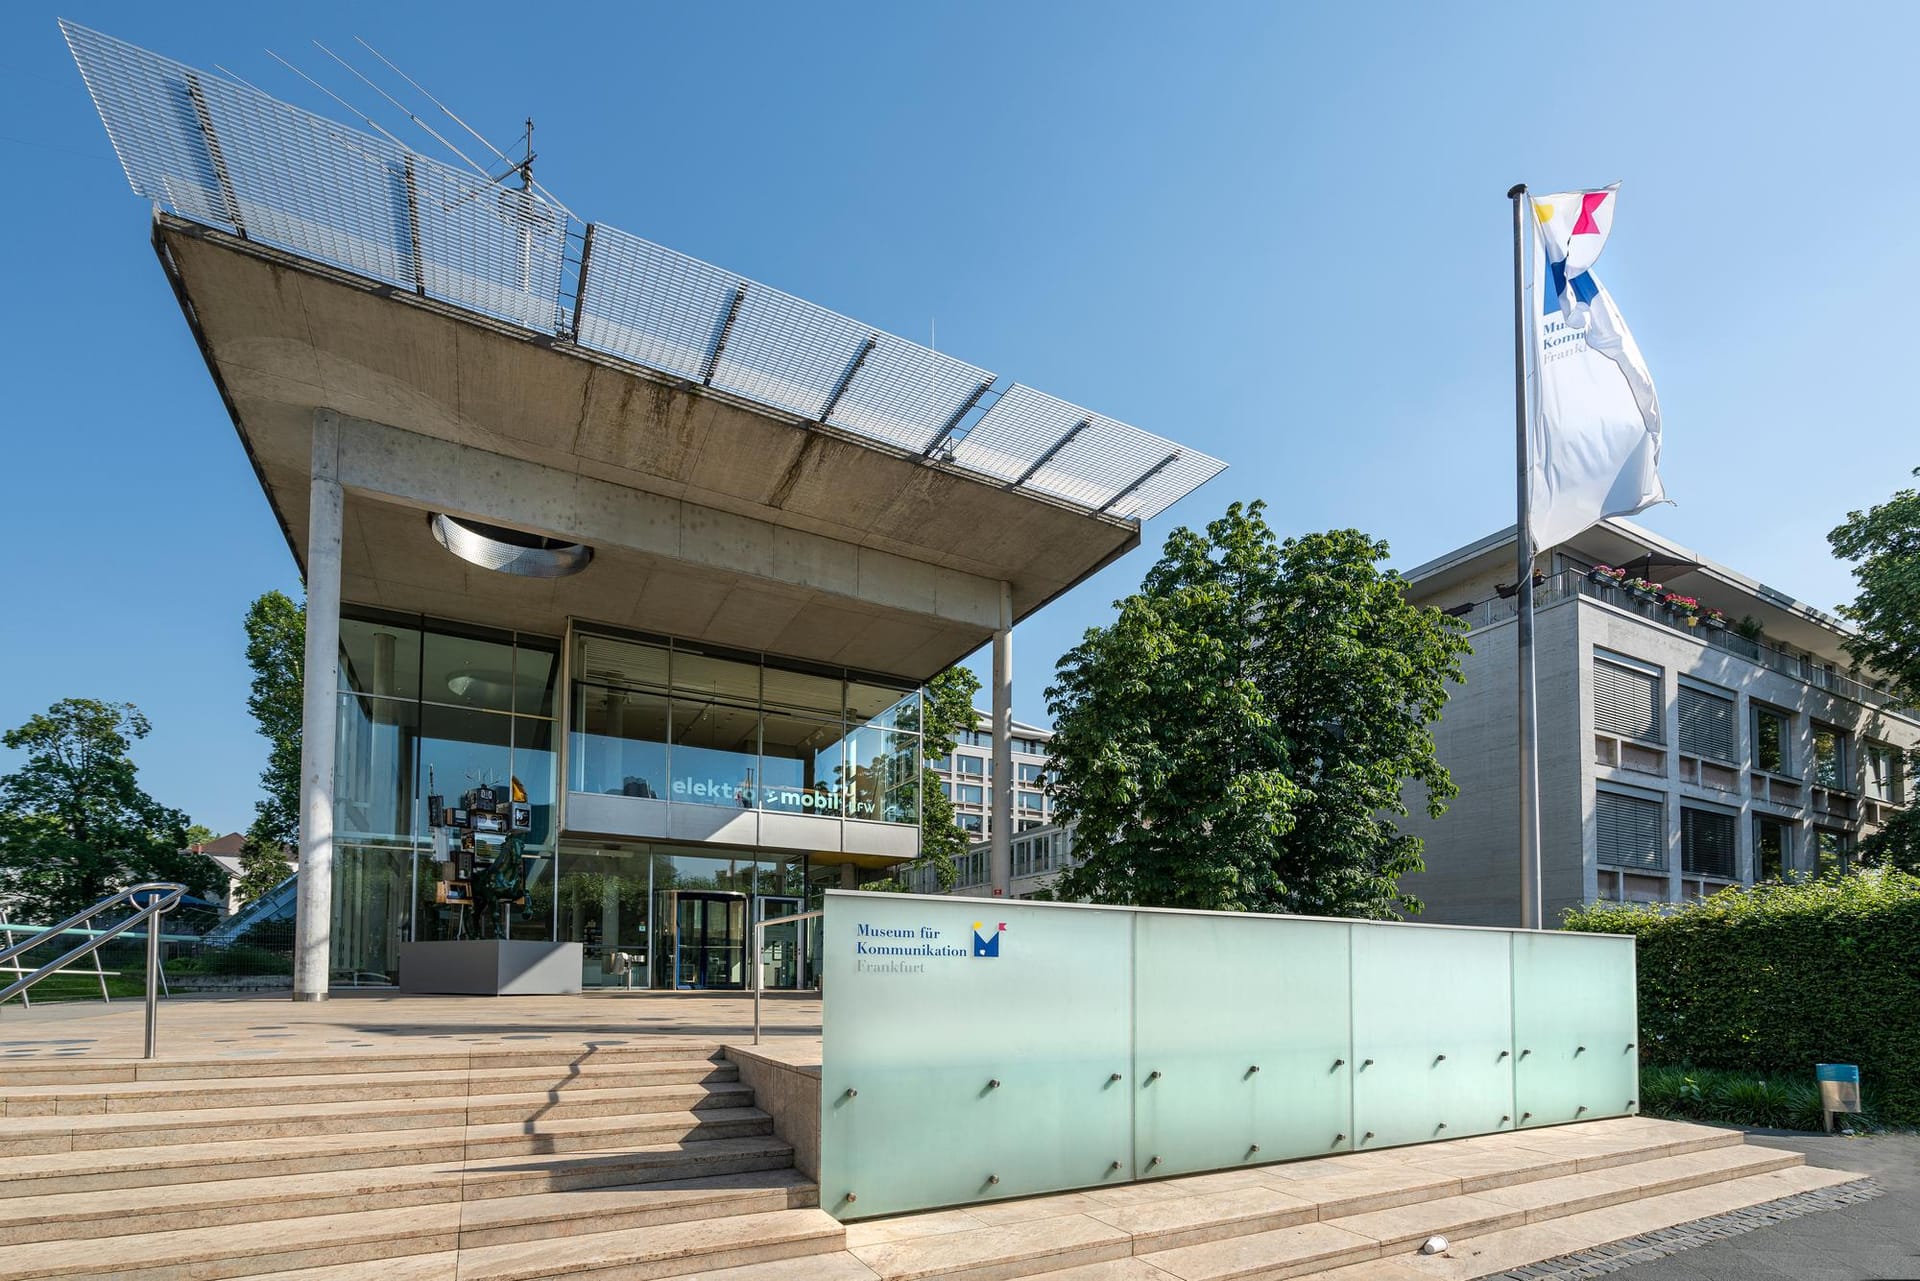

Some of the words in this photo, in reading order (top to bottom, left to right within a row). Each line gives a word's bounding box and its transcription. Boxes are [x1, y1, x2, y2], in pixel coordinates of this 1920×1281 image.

[857, 923, 915, 938] Museum
[920, 926, 940, 939] für
[857, 942, 967, 957] Kommunikation
[857, 960, 925, 973] Frankfurt
